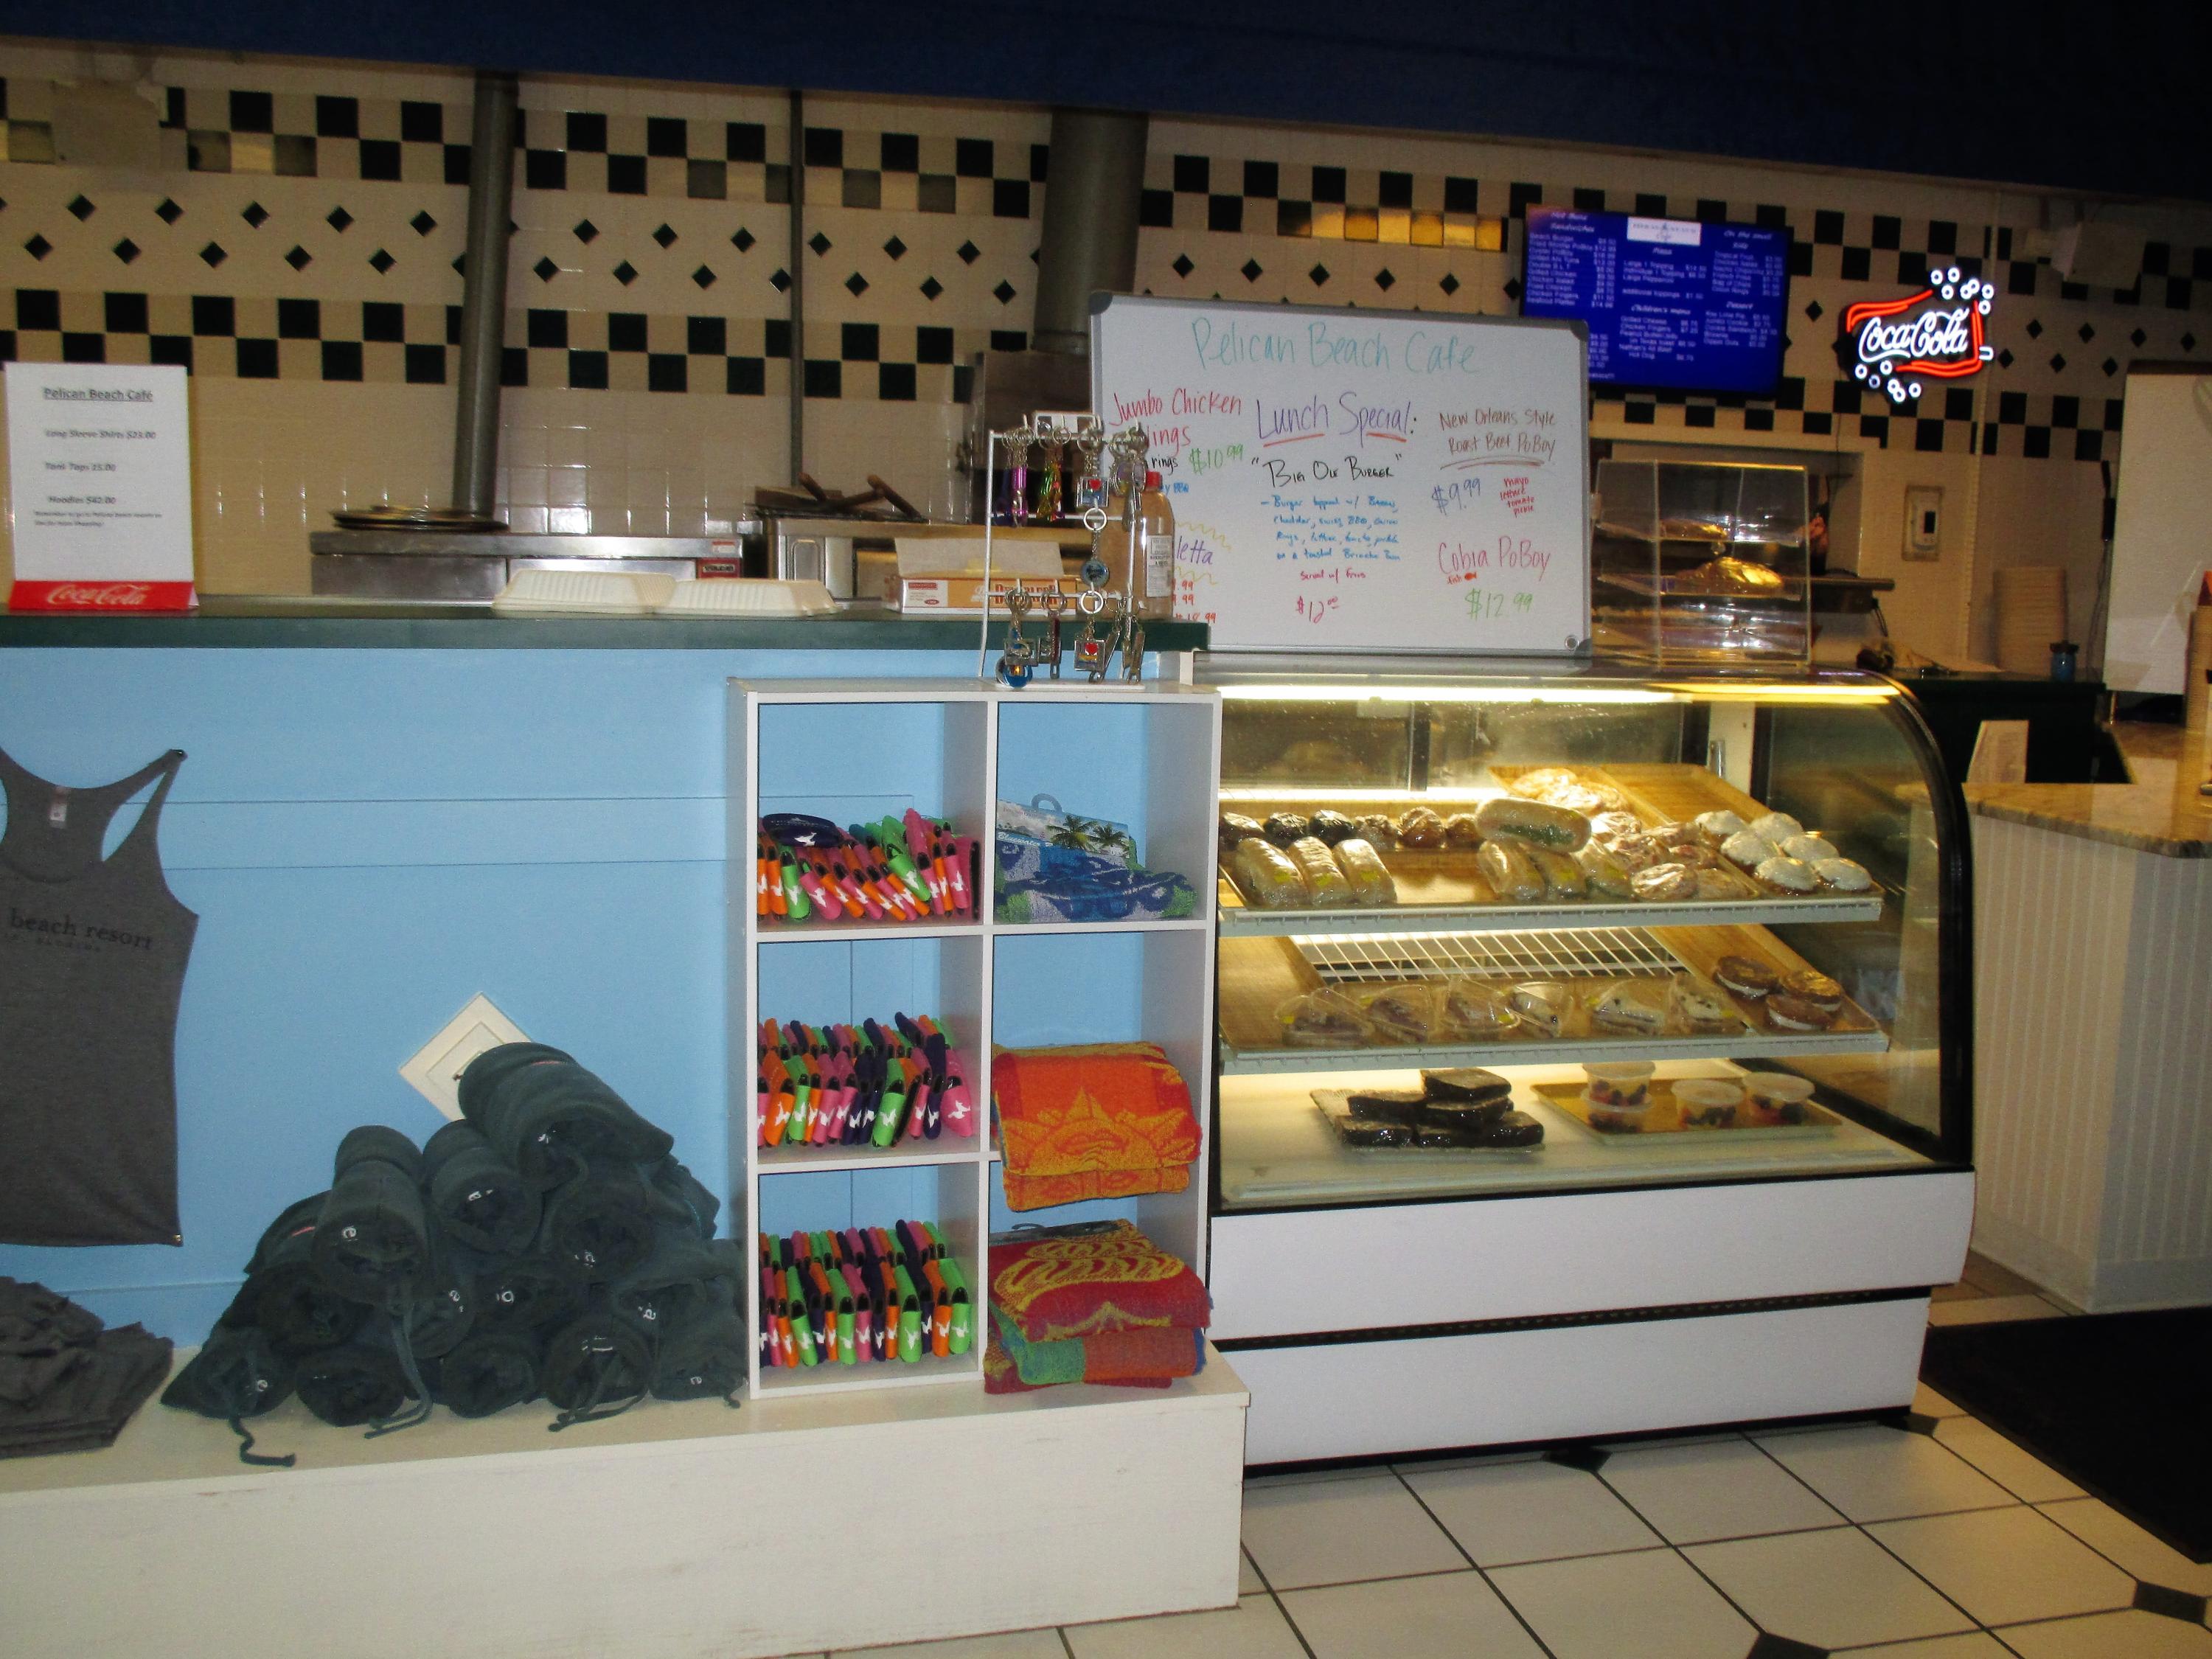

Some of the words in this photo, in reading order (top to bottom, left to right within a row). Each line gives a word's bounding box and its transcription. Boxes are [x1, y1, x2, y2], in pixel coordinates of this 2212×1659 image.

[1191, 316, 1296, 370] Pelican
[1308, 321, 1391, 370] Beach
[1405, 330, 1478, 374] Cafe
[43, 386, 86, 401] Pelican
[88, 387, 125, 402] Beach
[127, 389, 153, 403] Café
[1109, 389, 1163, 426] Jumbo
[1172, 388, 1242, 416] Chicken
[1256, 394, 1329, 440] Lunch
[1339, 391, 1417, 449] Special:
[1439, 413, 1469, 431] New
[1475, 407, 1518, 426] Orleans
[1525, 408, 1558, 431] Style
[1448, 435, 1479, 456] Roast
[1151, 454, 1178, 476] rings
[1439, 542, 1489, 575] Cobia
[1498, 535, 1552, 582] PoBoy
[10, 907, 77, 937] beach
[85, 924, 153, 951] resort
